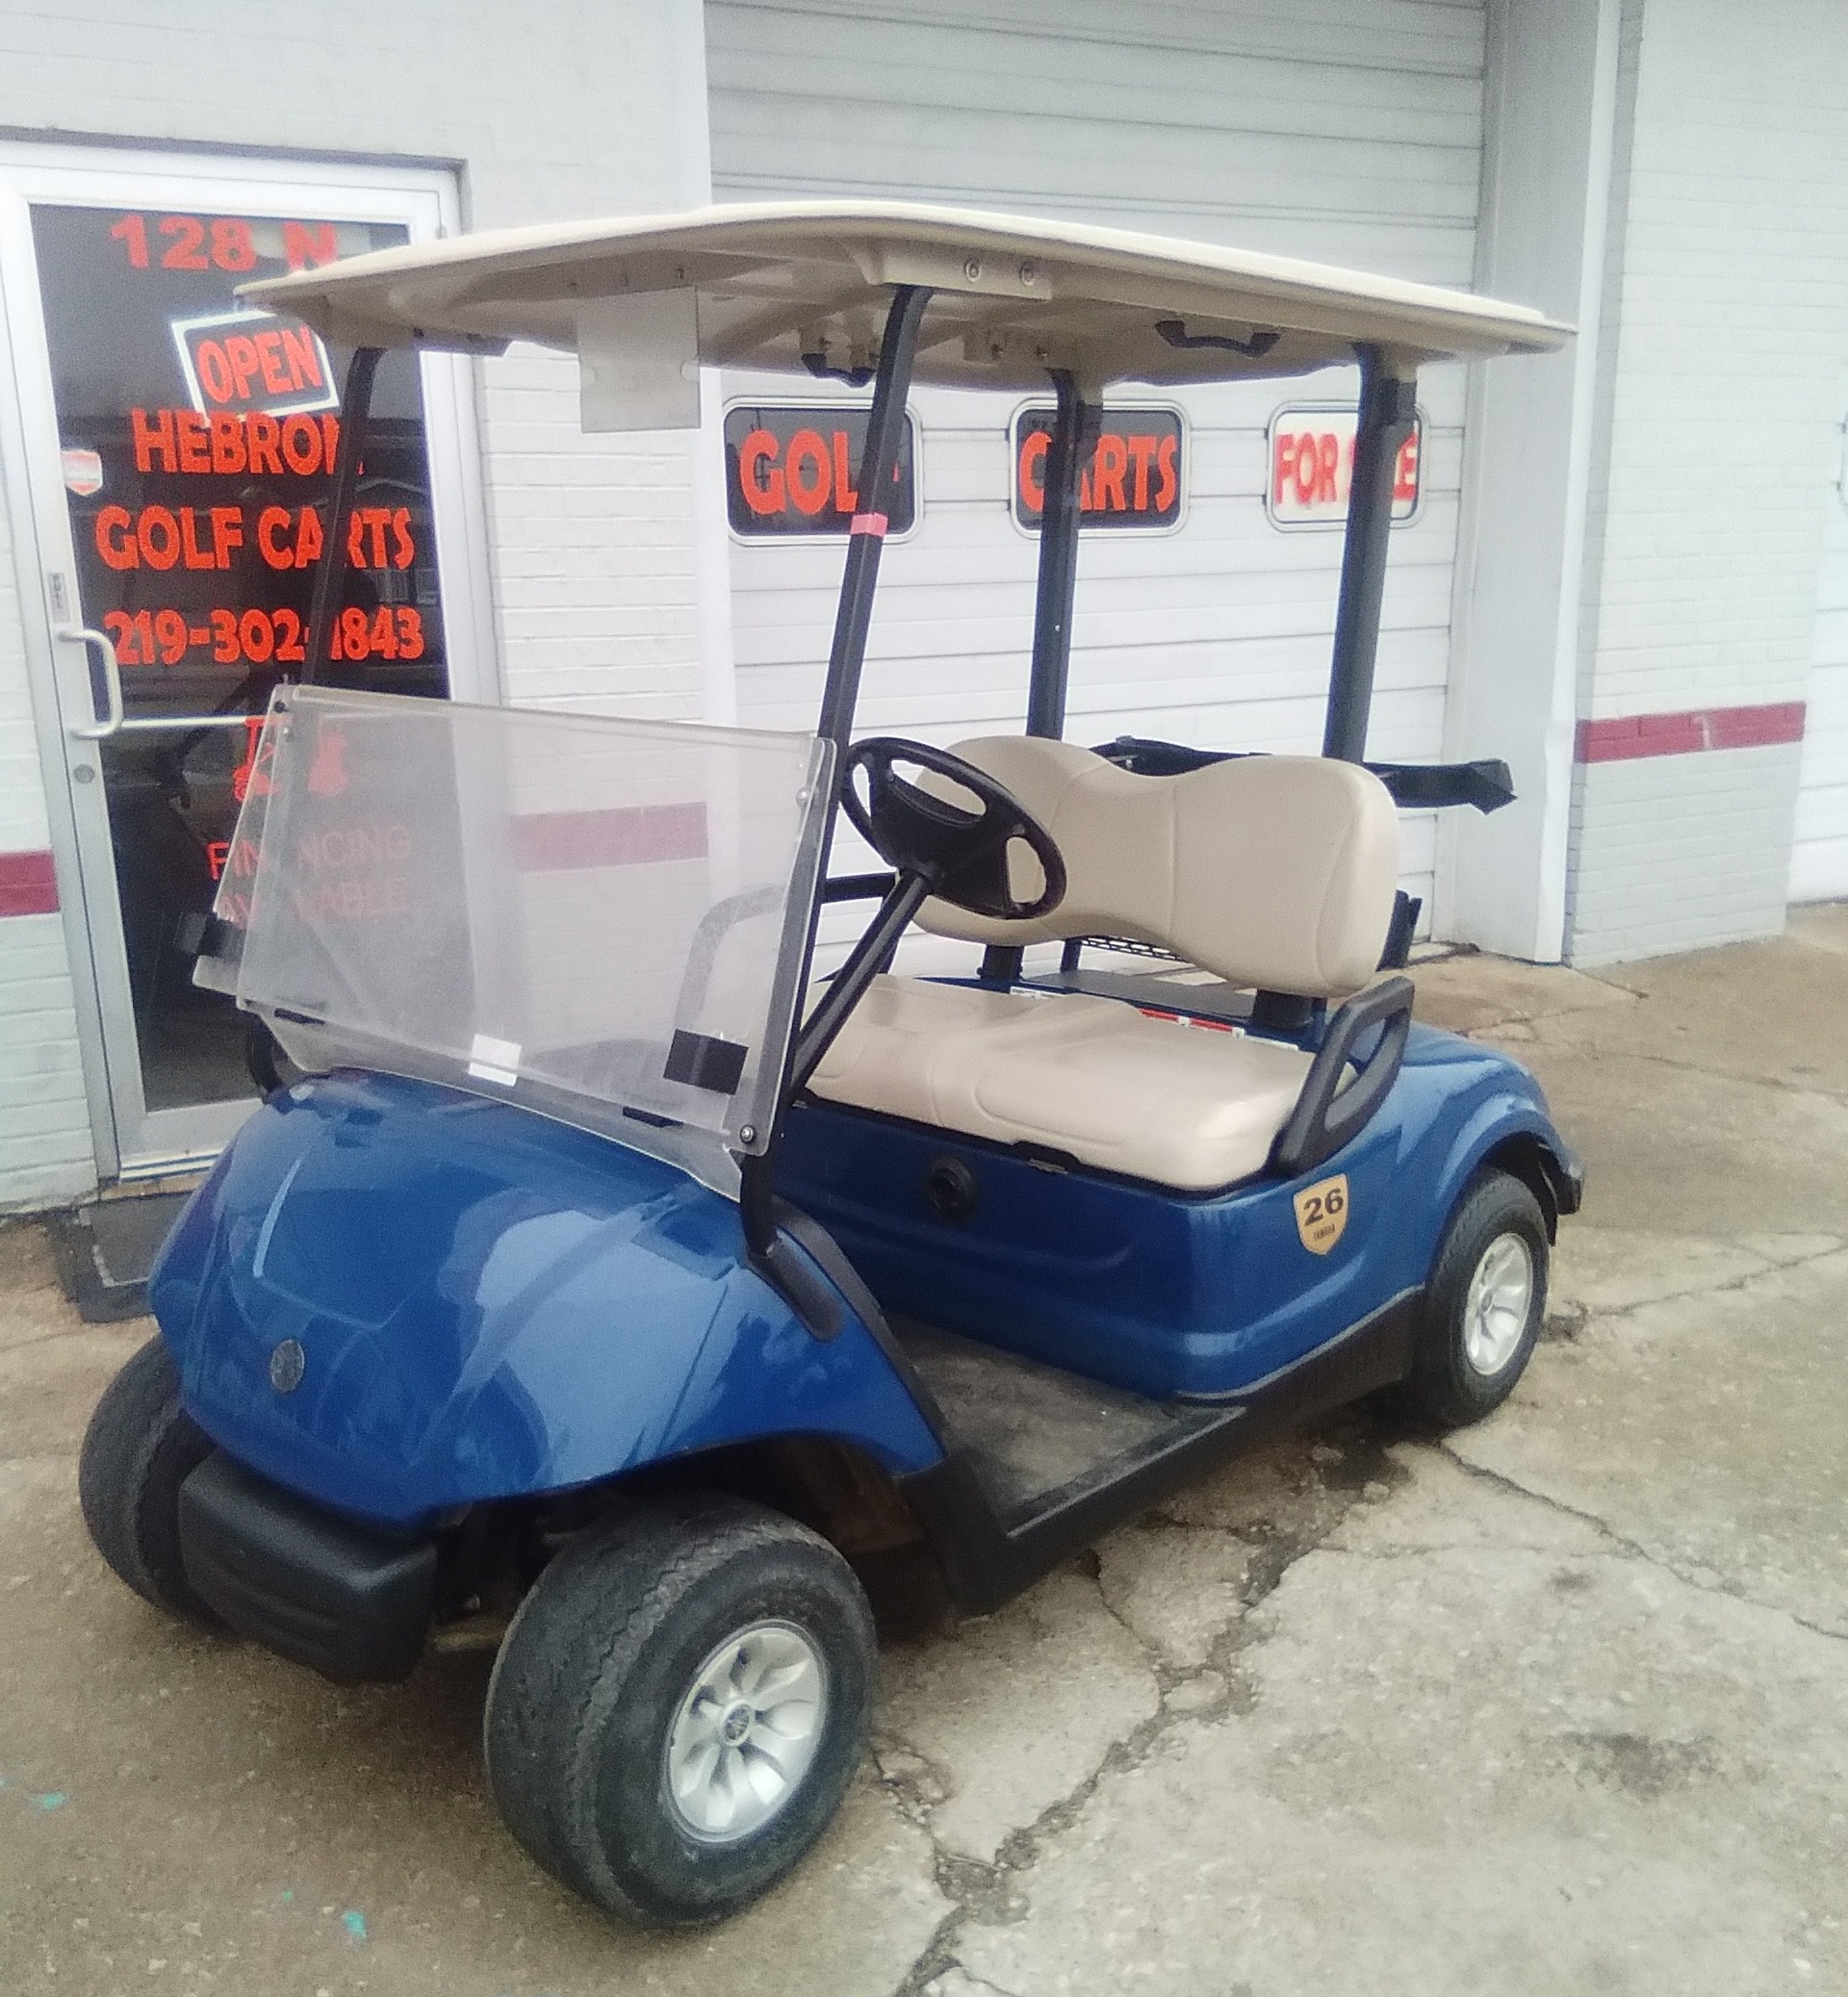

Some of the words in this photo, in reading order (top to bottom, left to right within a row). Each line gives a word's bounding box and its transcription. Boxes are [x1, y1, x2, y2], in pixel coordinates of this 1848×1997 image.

[110, 213, 257, 272] 128
[284, 220, 335, 272] N
[196, 325, 322, 403] OPEN
[739, 428, 900, 515] GOL
[1019, 431, 1176, 512] CRTS
[1275, 432, 1338, 505] FOR
[96, 505, 243, 570] GOLF
[104, 606, 424, 665] 219-3021843
[206, 825, 412, 881] FINNCING
[1302, 1187, 1344, 1226] 26
